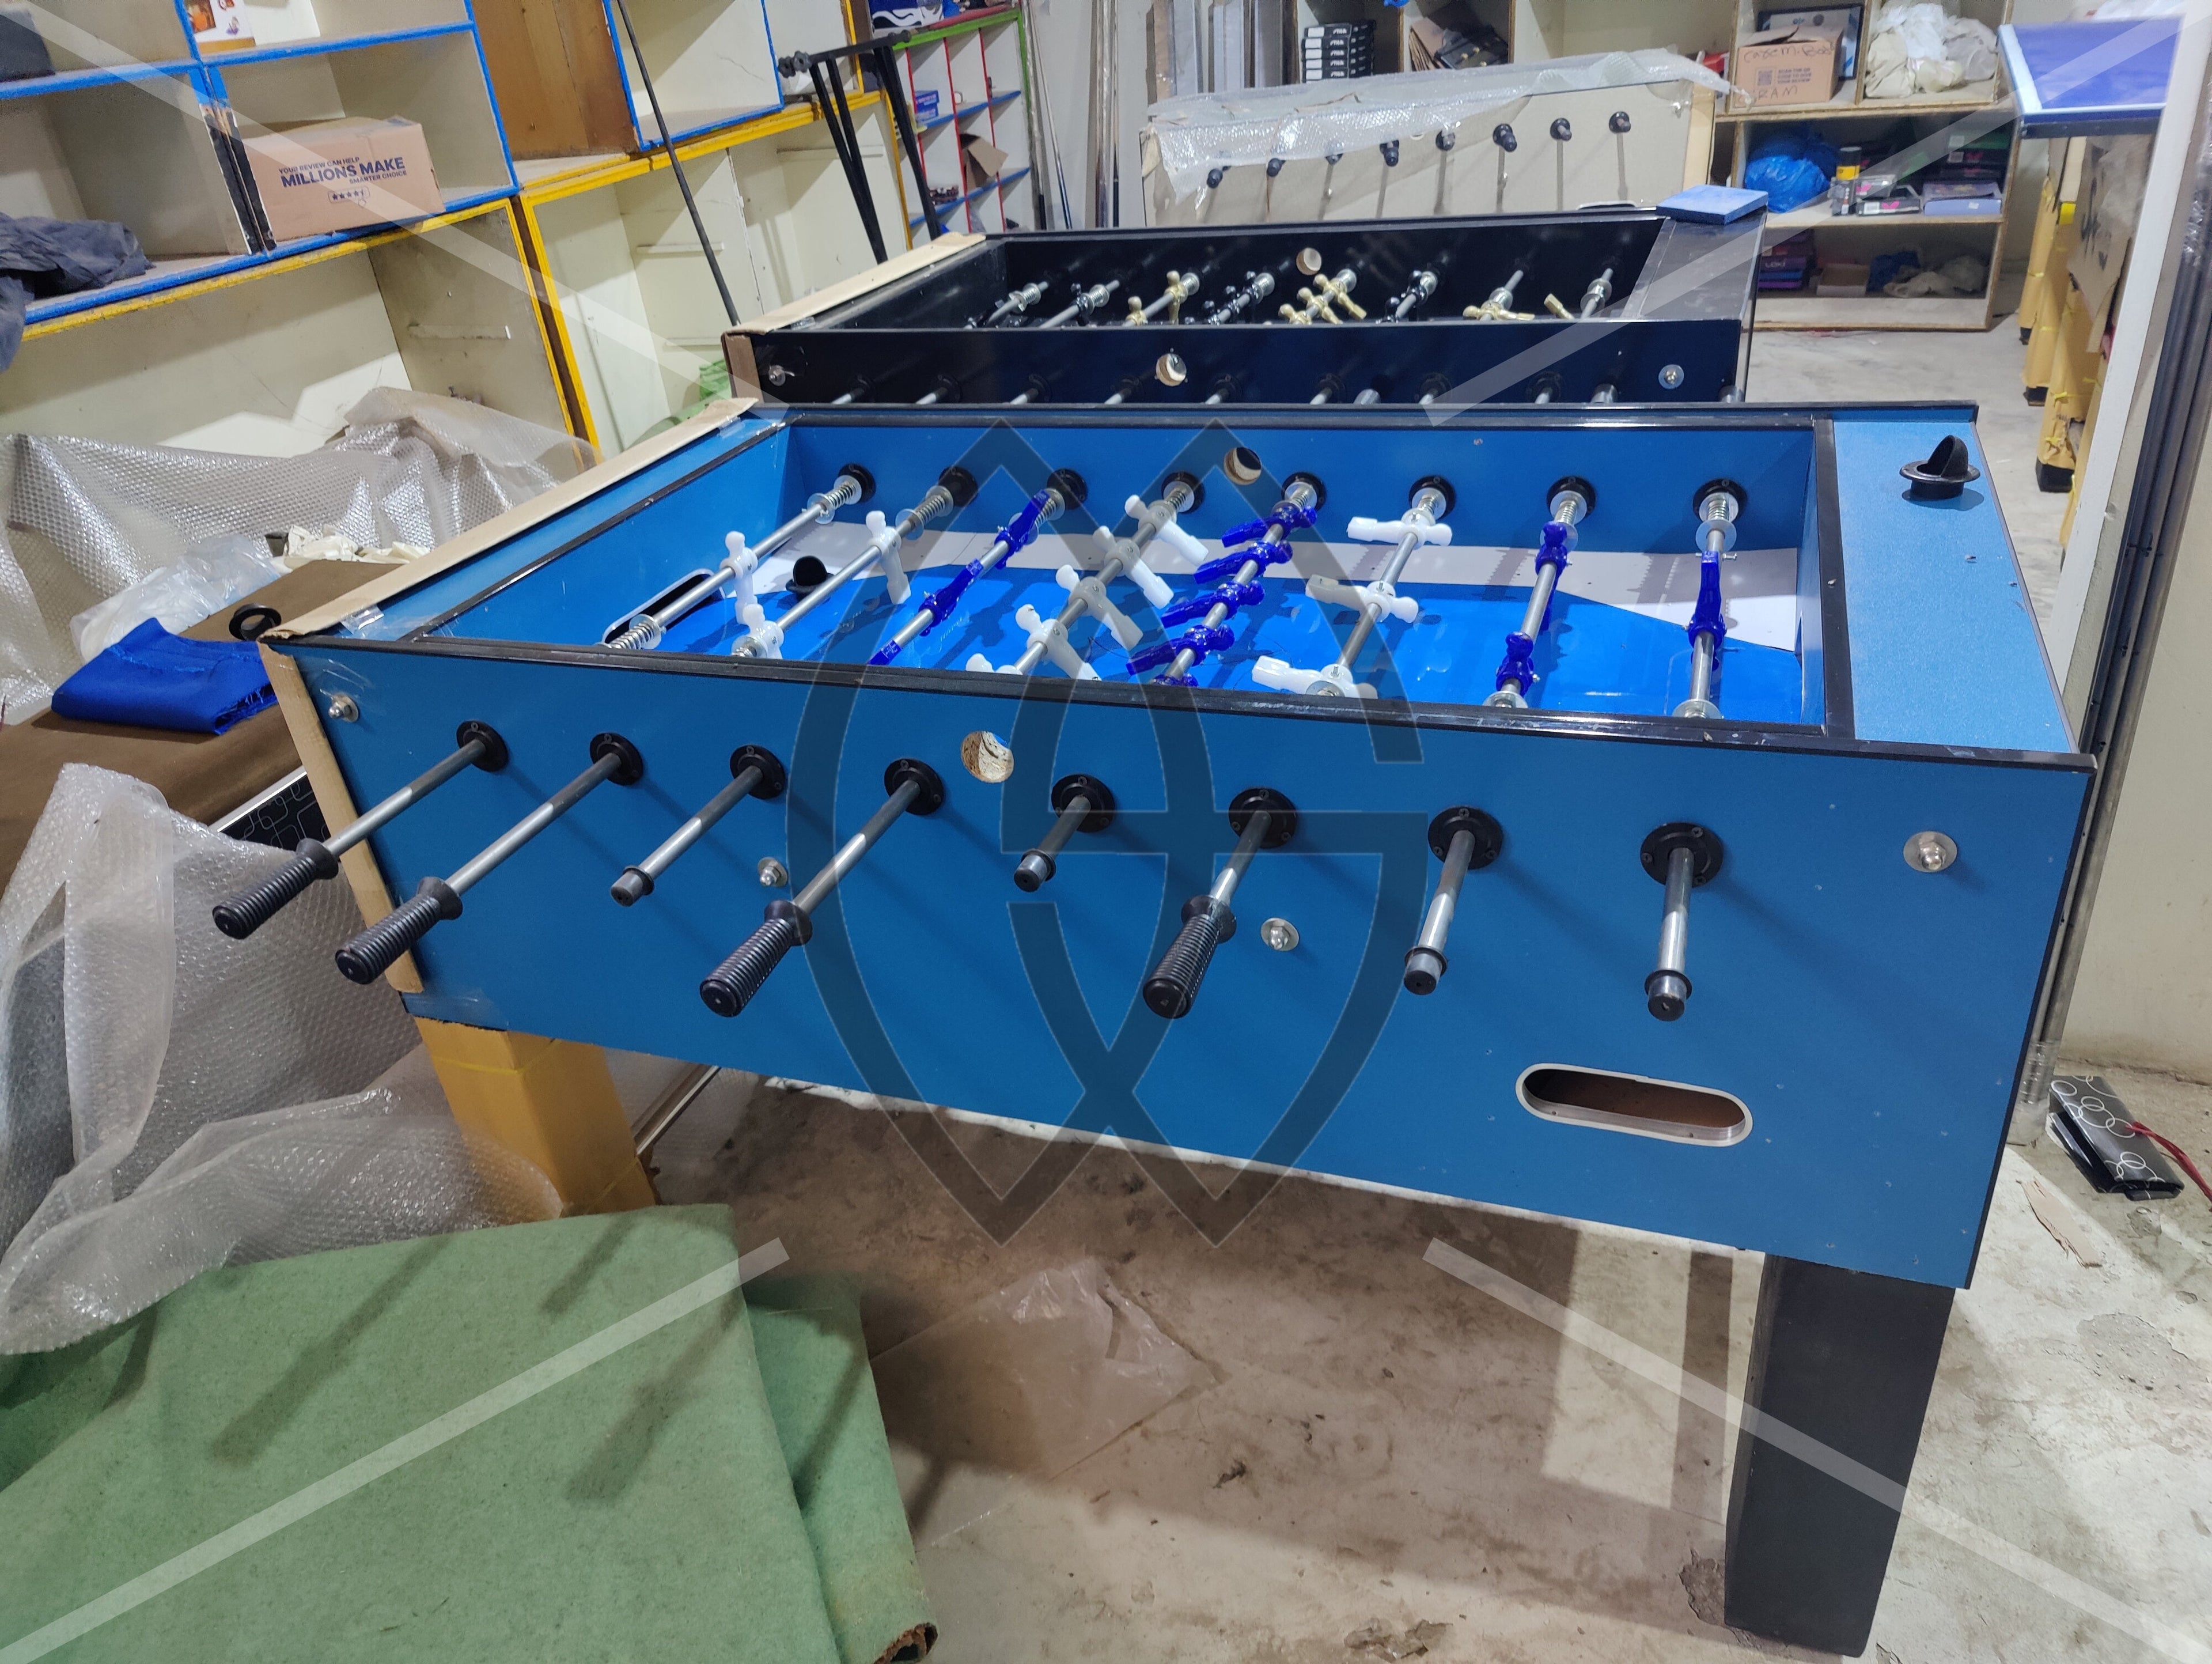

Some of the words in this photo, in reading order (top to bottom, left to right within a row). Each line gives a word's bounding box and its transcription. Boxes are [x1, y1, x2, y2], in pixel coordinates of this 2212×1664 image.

[279, 166, 298, 175] YOUR
[299, 162, 325, 172] REVIEW
[327, 159, 342, 167] CAN
[342, 156, 359, 165] HELP
[281, 164, 357, 188] MILLIONS
[359, 157, 406, 175] MAKE
[349, 174, 381, 184] SMARTER
[382, 170, 407, 179] CHOICE
